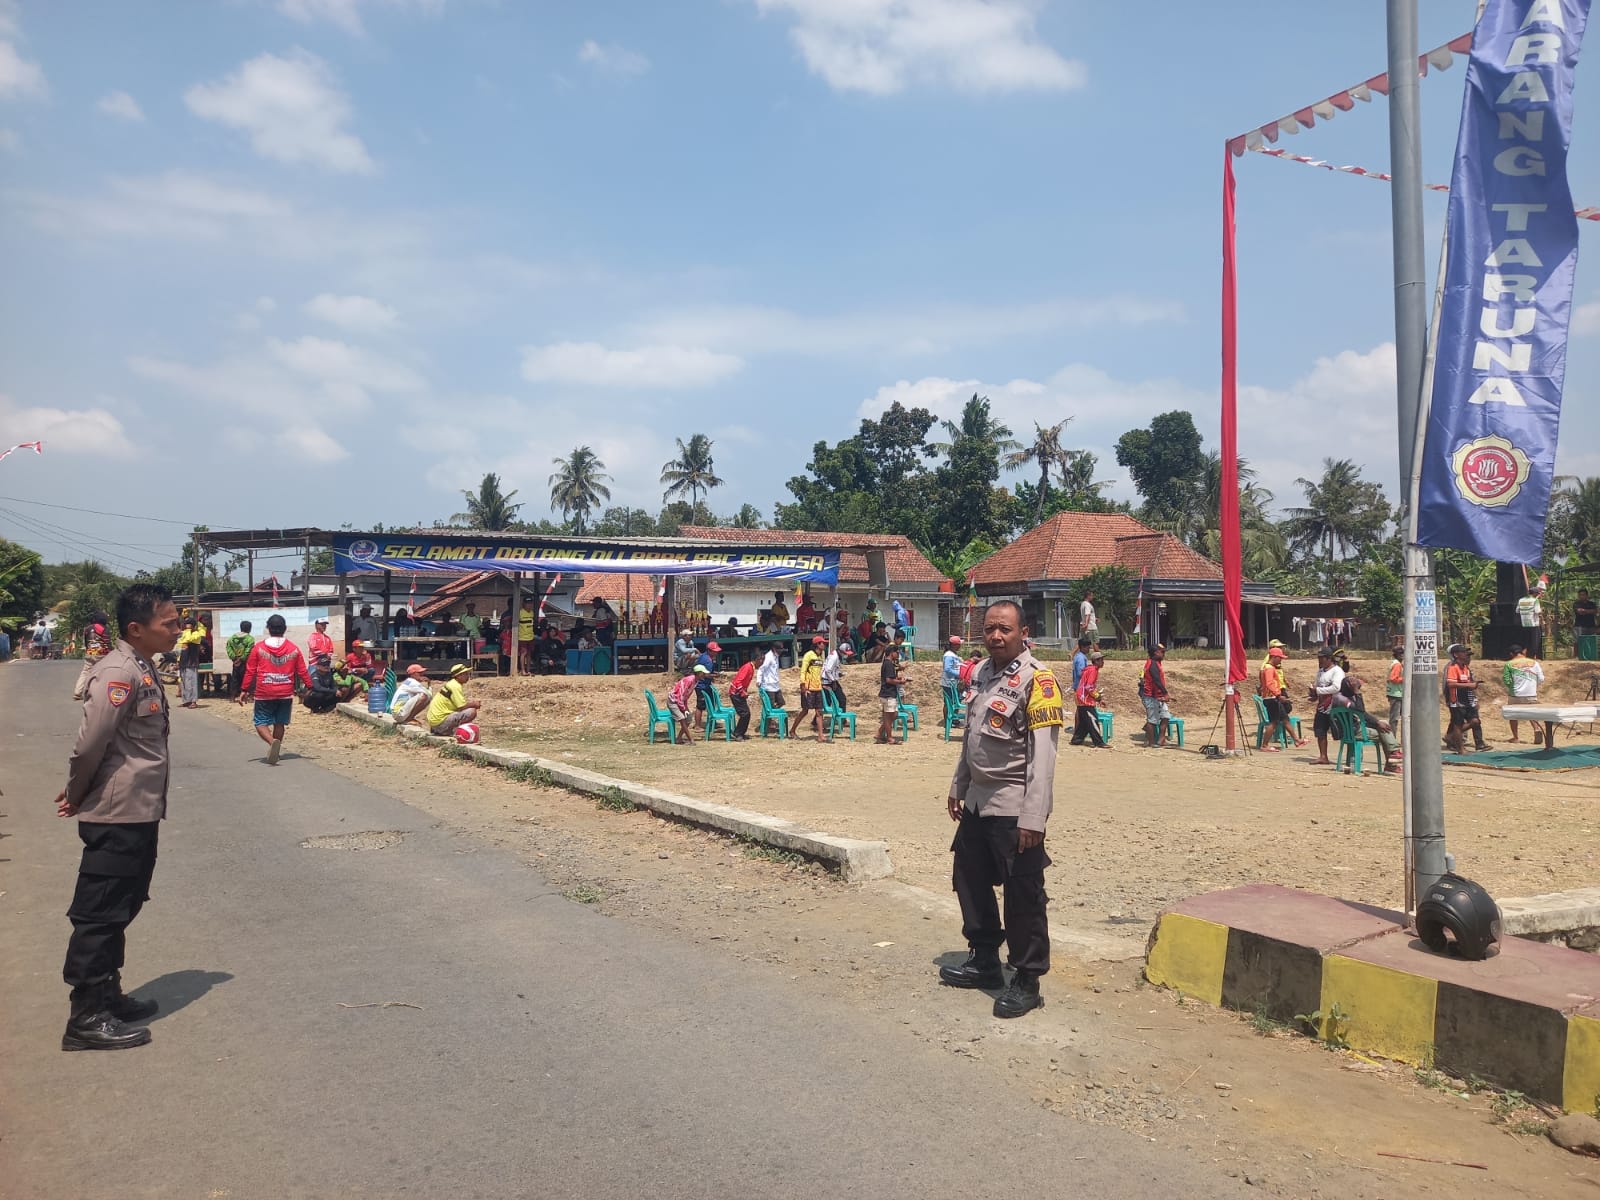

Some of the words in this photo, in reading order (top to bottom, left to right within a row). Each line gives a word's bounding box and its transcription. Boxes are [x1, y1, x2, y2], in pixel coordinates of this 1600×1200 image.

[1467, 203, 1548, 407] TARUNA
[381, 545, 493, 560] SELAMAT
[494, 547, 588, 561] DATANG
[740, 553, 825, 571] BANGSA
[1416, 598, 1434, 607] WC
[1416, 641, 1434, 650] WC
[997, 686, 1020, 700] POLRI
